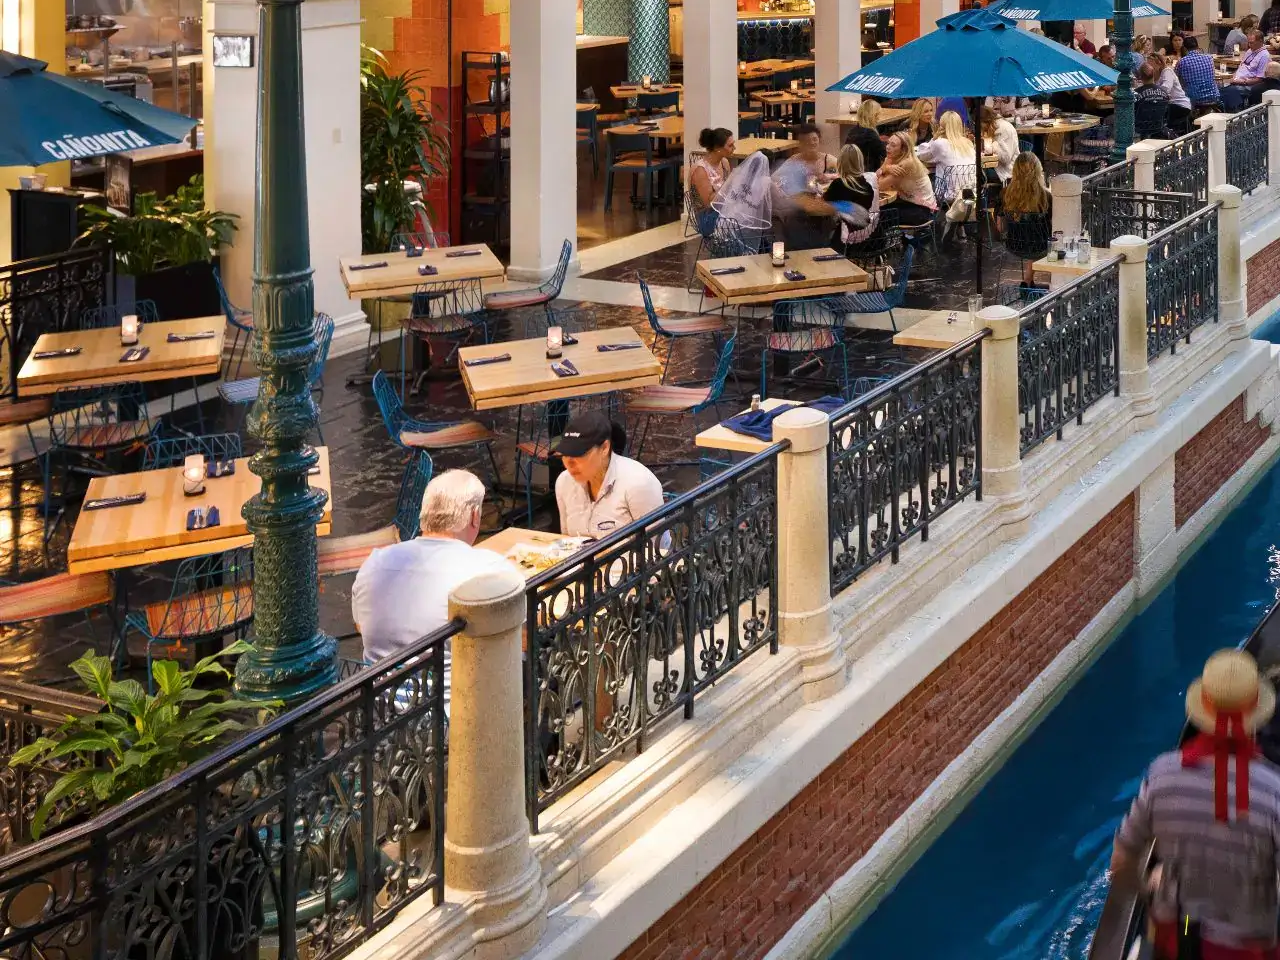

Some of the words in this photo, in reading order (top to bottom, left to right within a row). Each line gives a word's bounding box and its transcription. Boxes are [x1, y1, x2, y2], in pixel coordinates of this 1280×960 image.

[844, 72, 905, 95] CAÑONITA
[1024, 70, 1097, 92] CAÑONITA
[41, 129, 152, 160] CAÑONITA
